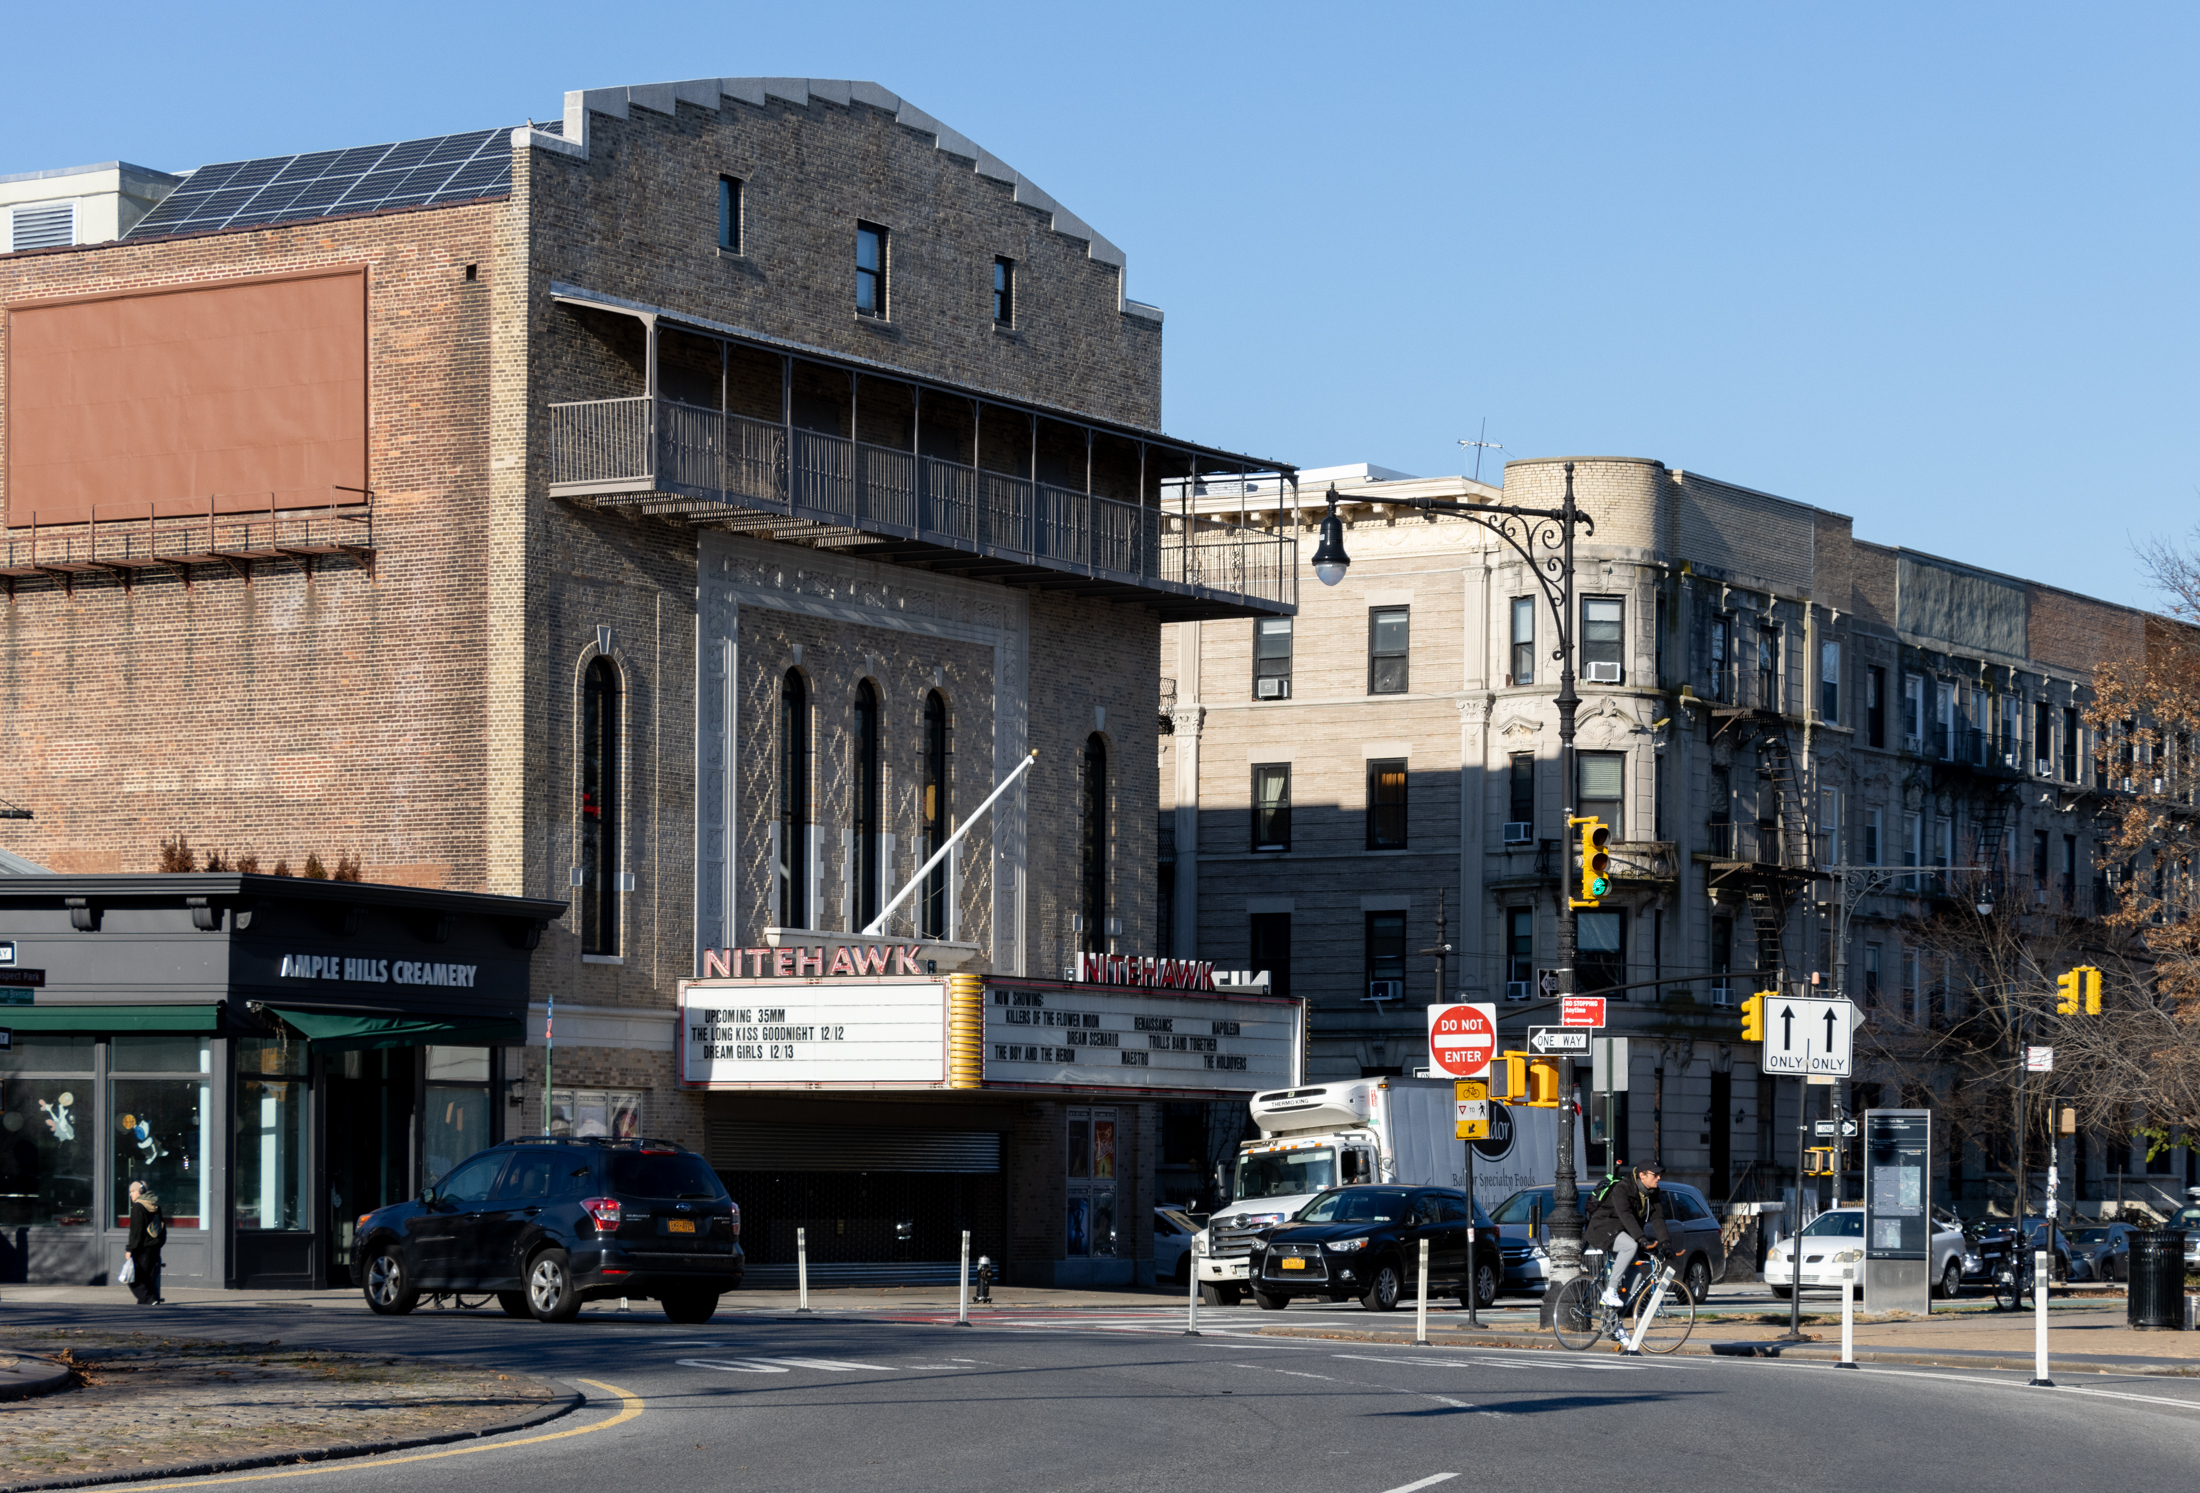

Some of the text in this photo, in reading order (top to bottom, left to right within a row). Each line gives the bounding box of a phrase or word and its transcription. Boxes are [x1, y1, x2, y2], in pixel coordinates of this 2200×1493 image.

[704, 945, 922, 978] NITEHAWK
[23, 972, 40, 981] Park
[280, 954, 478, 987] AMPLE HILLS CREAMERY
[1080, 951, 1217, 991] NITEHAWK
[1544, 977, 1556, 989] ONE
[994, 990, 1044, 1007] NOW SHOWING:
[704, 1008, 786, 1024] UPCOMING 35MM
[1565, 1007, 1587, 1015] Anytime
[1005, 1009, 1100, 1029] KILLERS OF THE FLOWER MOON
[1134, 1016, 1173, 1033] RENAISSANCE
[1441, 1018, 1484, 1031] DO NOT
[691, 1026, 845, 1042] THE LONG KISS GOODNIGHT 12/12
[1211, 1021, 1241, 1036] NAPOLEON
[1066, 1030, 1119, 1048] DREAM SCENARIO
[1148, 1035, 1218, 1052] TROLLS BAND TOGETHER
[1537, 1035, 1583, 1047] ONE WAY
[703, 1044, 794, 1059] DREAM GIRLS 12/13
[994, 1045, 1076, 1063] THE BOY AND THE HERON
[1121, 1051, 1149, 1066] MAESTRO
[1444, 1051, 1482, 1063] ENTER
[1203, 1055, 1247, 1070] THE HOLDOVERS
[1770, 1055, 1803, 1068] ONLY
[1811, 1057, 1845, 1070] ONLY
[1271, 1097, 1309, 1107] THERMO KING
[1479, 1167, 1513, 1191] Specialty
[1514, 1167, 1536, 1188] Foods
